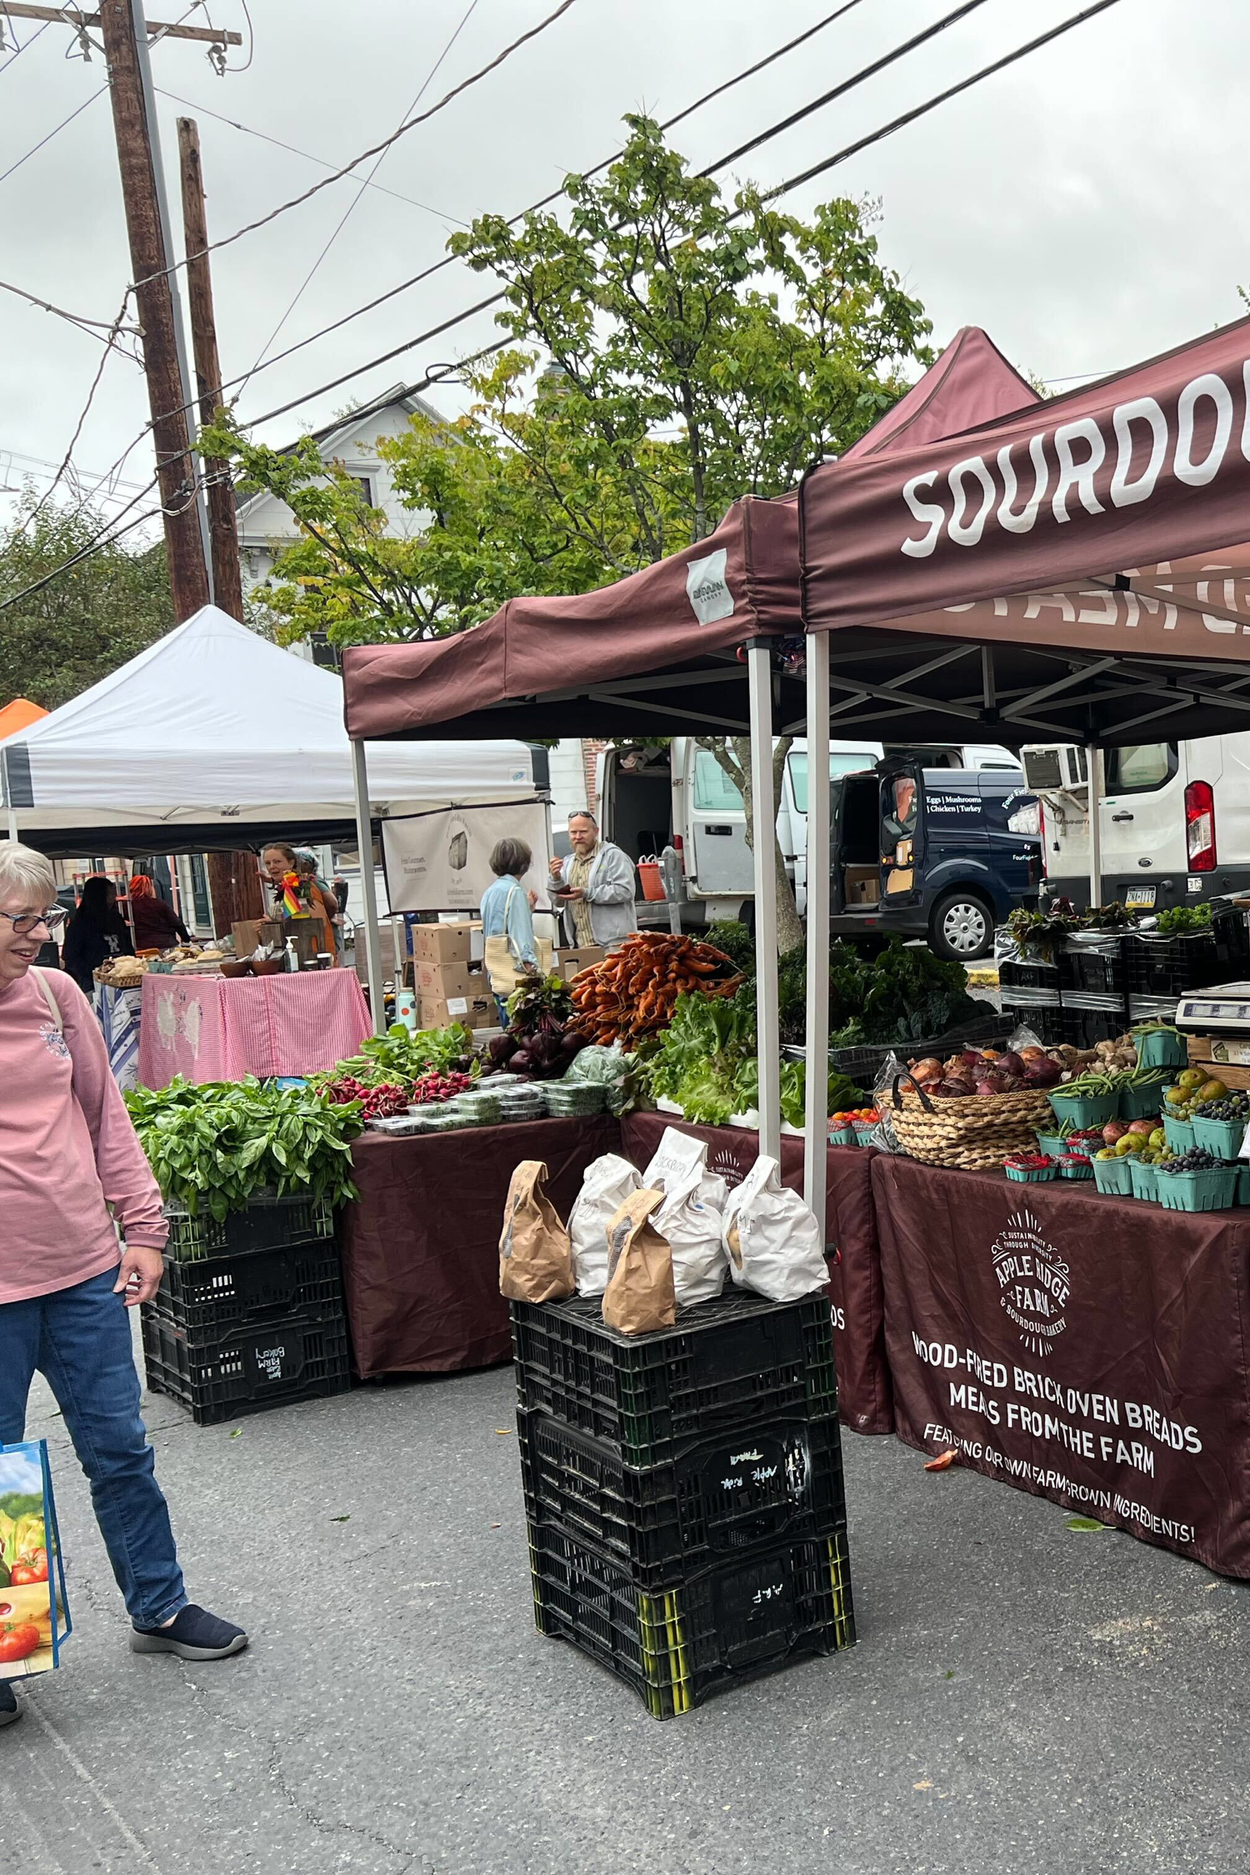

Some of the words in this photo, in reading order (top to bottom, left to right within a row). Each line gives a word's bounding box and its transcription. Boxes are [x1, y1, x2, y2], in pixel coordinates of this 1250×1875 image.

[926, 796, 941, 804] Eggs
[945, 796, 982, 804] Mushrooms
[930, 805, 956, 813] Chicken
[960, 805, 982, 814] Turkey
[1003, 1241, 1029, 1249] THROUGH
[995, 1255, 1034, 1288] APPLE
[1035, 1257, 1070, 1308] RIDGE
[1015, 1285, 1050, 1318] FARM
[1013, 1365, 1065, 1409] BRICK
[1066, 1387, 1120, 1426] OVEN
[1124, 1402, 1203, 1454] BREADS
[1006, 1402, 1060, 1441] FROM
[1060, 1423, 1095, 1459] THE
[1100, 1436, 1155, 1479] FARM
